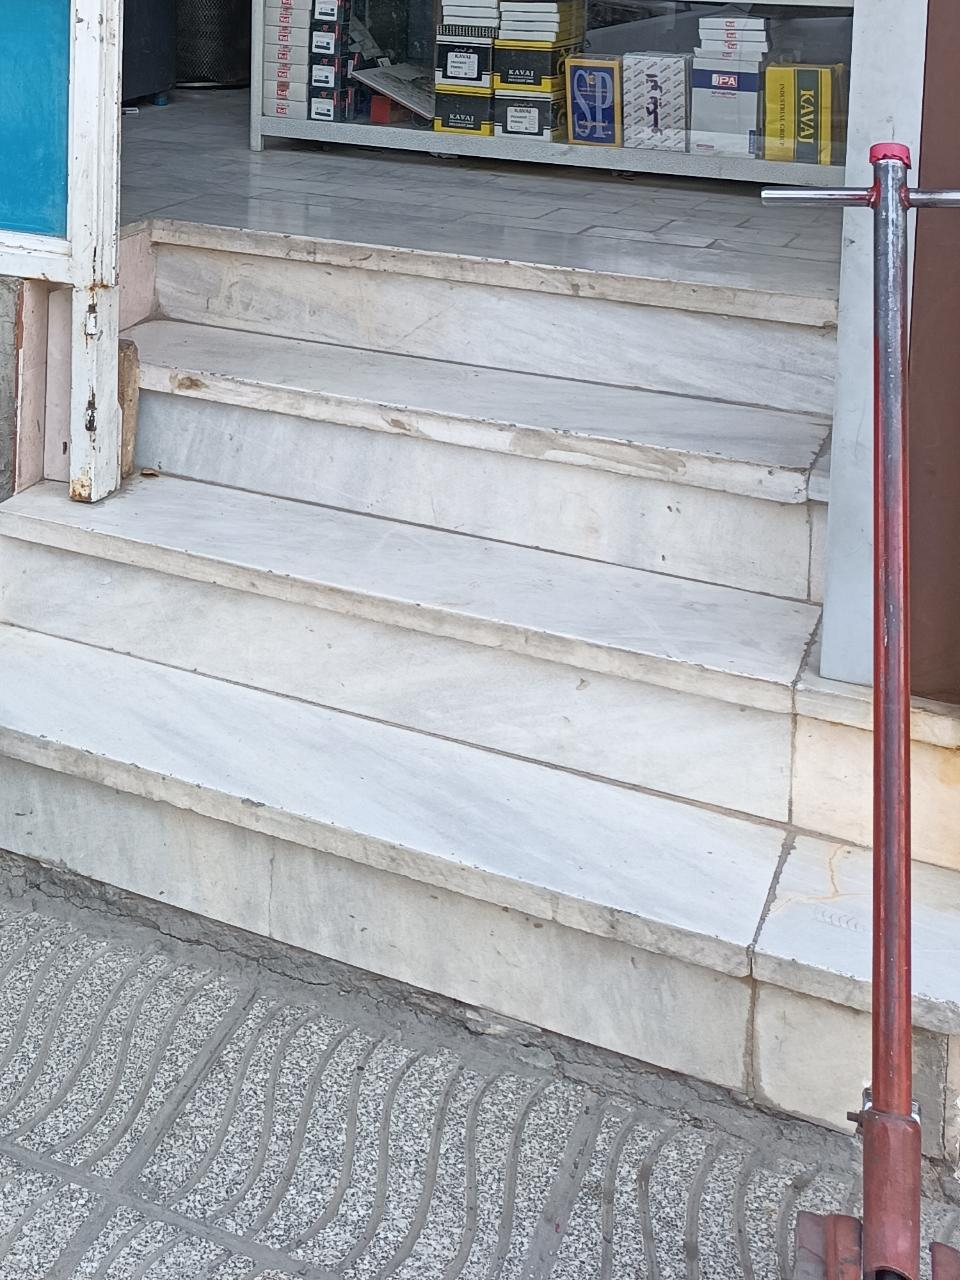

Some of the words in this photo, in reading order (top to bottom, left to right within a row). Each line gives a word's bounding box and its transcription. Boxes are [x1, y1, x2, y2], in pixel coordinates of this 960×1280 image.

[508, 69, 535, 77] KAVAJ
[712, 73, 738, 88] IPA
[448, 113, 475, 122] KAVAJ
[799, 88, 815, 144] KAVAJ
